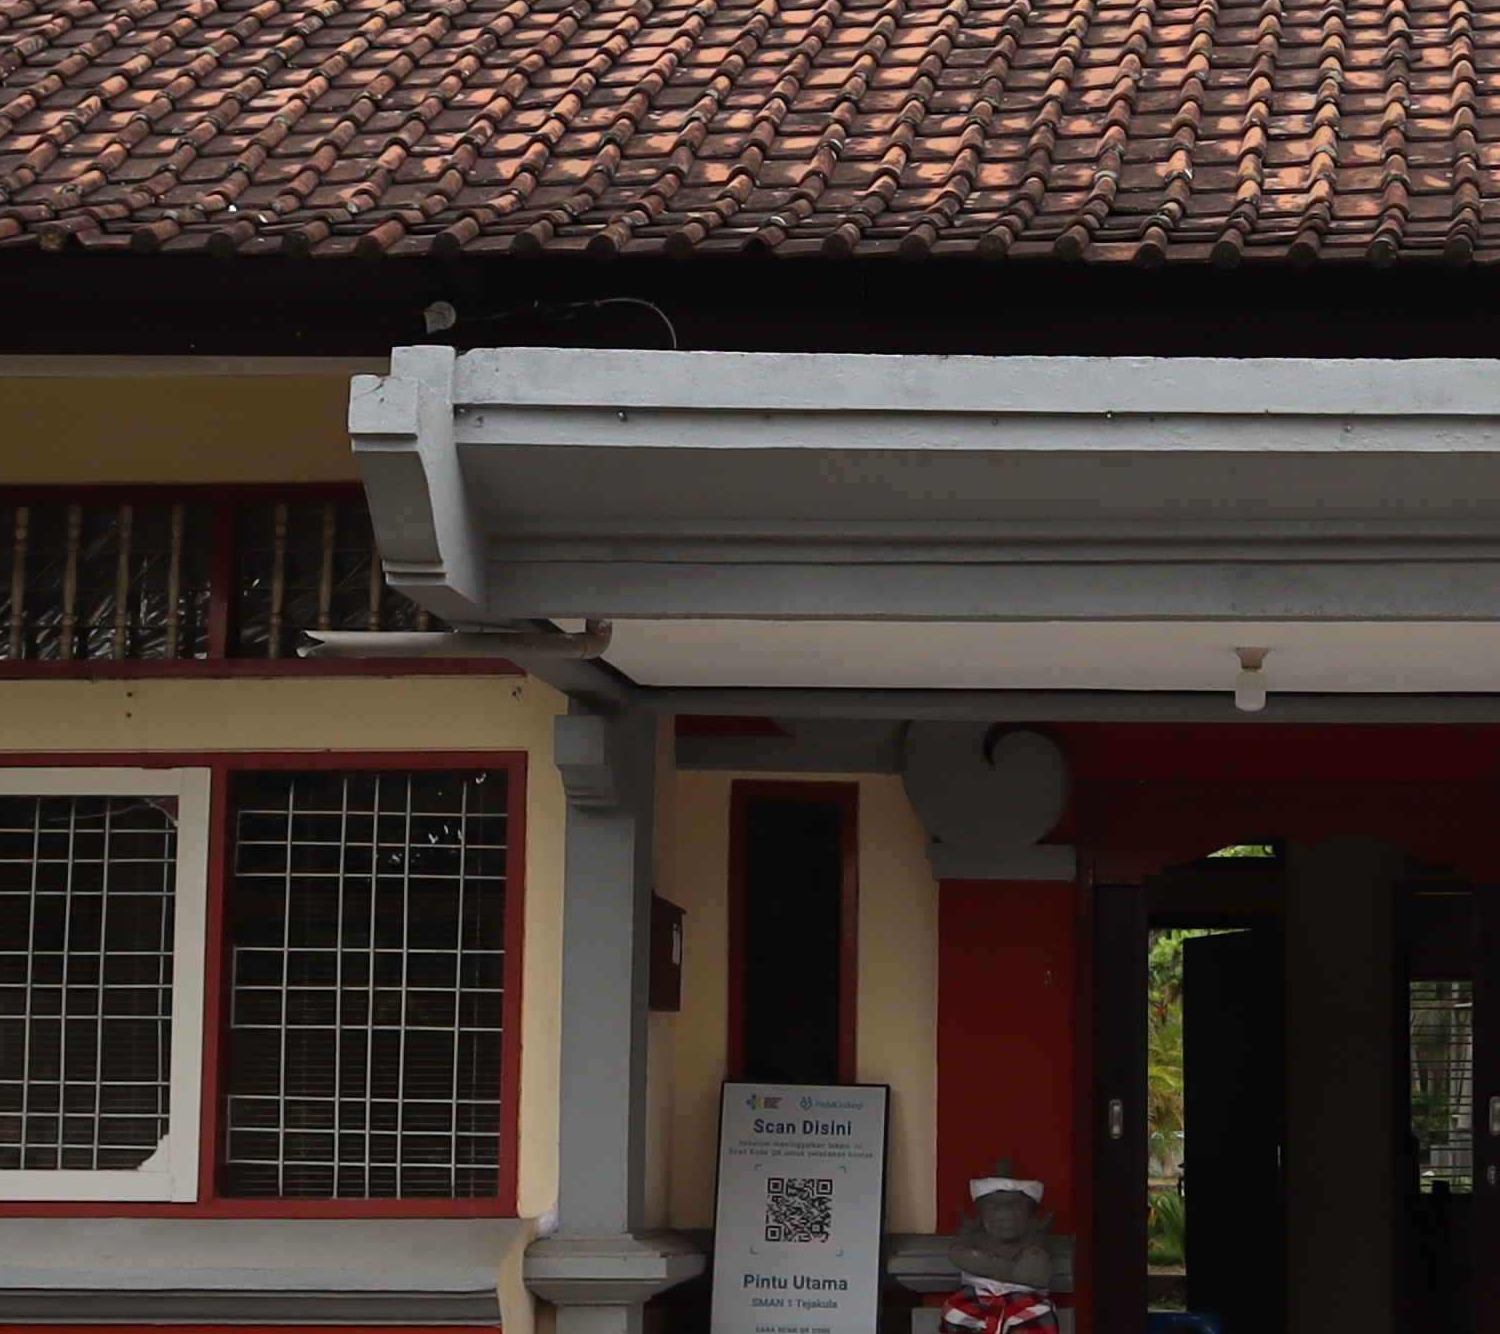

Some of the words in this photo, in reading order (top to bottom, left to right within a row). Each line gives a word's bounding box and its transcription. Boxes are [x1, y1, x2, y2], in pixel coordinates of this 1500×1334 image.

[753, 1118, 796, 1134] Scan
[803, 1120, 852, 1135] Disini
[743, 1273, 788, 1289] Pintu
[793, 1275, 848, 1290] Utama
[751, 1298, 784, 1307] SMAN
[788, 1299, 792, 1307] 1
[796, 1299, 838, 1310] Tejakula
